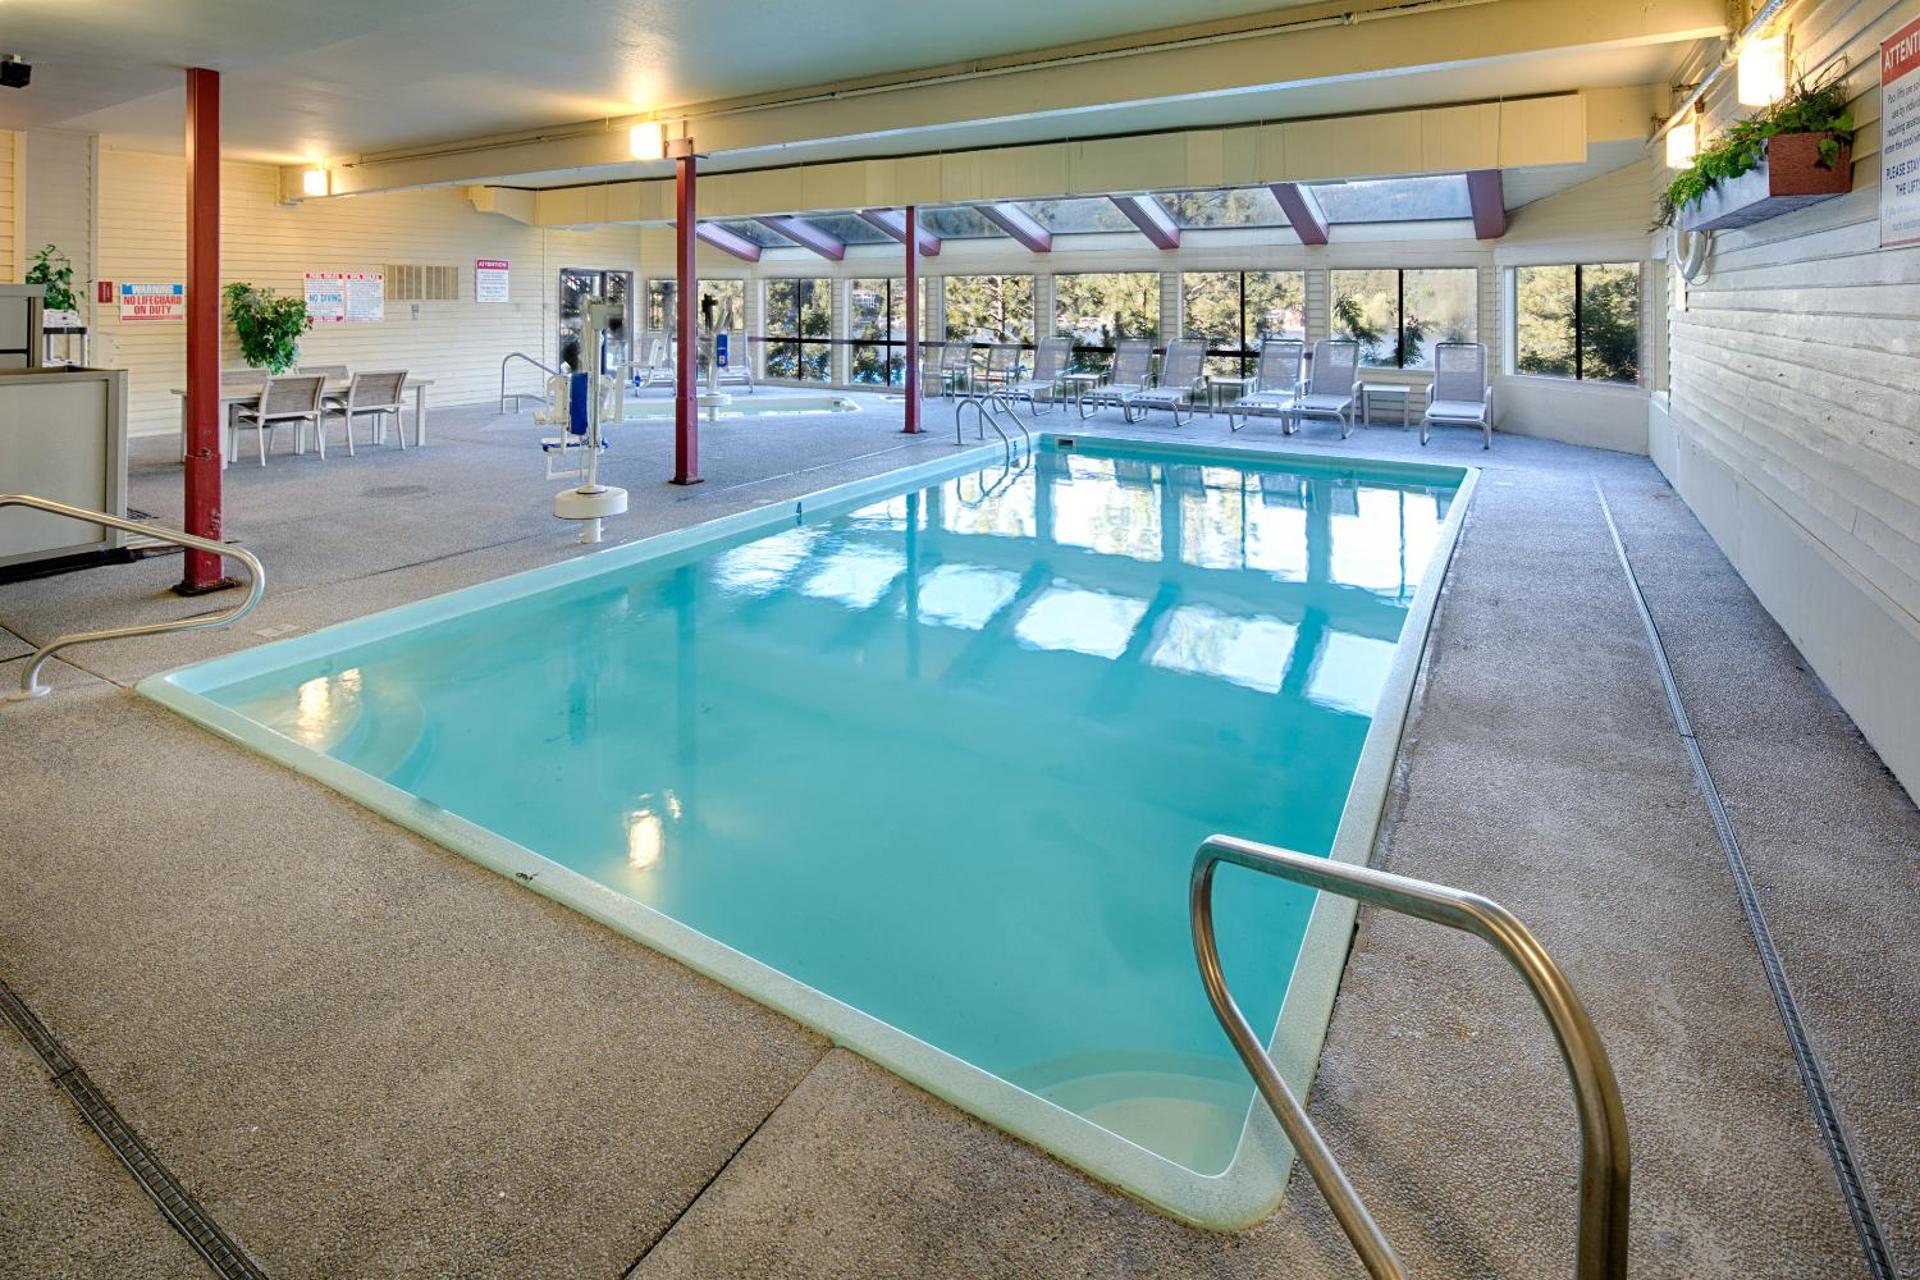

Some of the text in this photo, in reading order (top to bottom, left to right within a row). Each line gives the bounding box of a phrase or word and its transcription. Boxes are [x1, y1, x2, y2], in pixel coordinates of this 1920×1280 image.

[123, 295, 182, 305] NO LIFEGUARD
[320, 293, 343, 303] DIVING
[134, 305, 172, 315] ON DUTY
